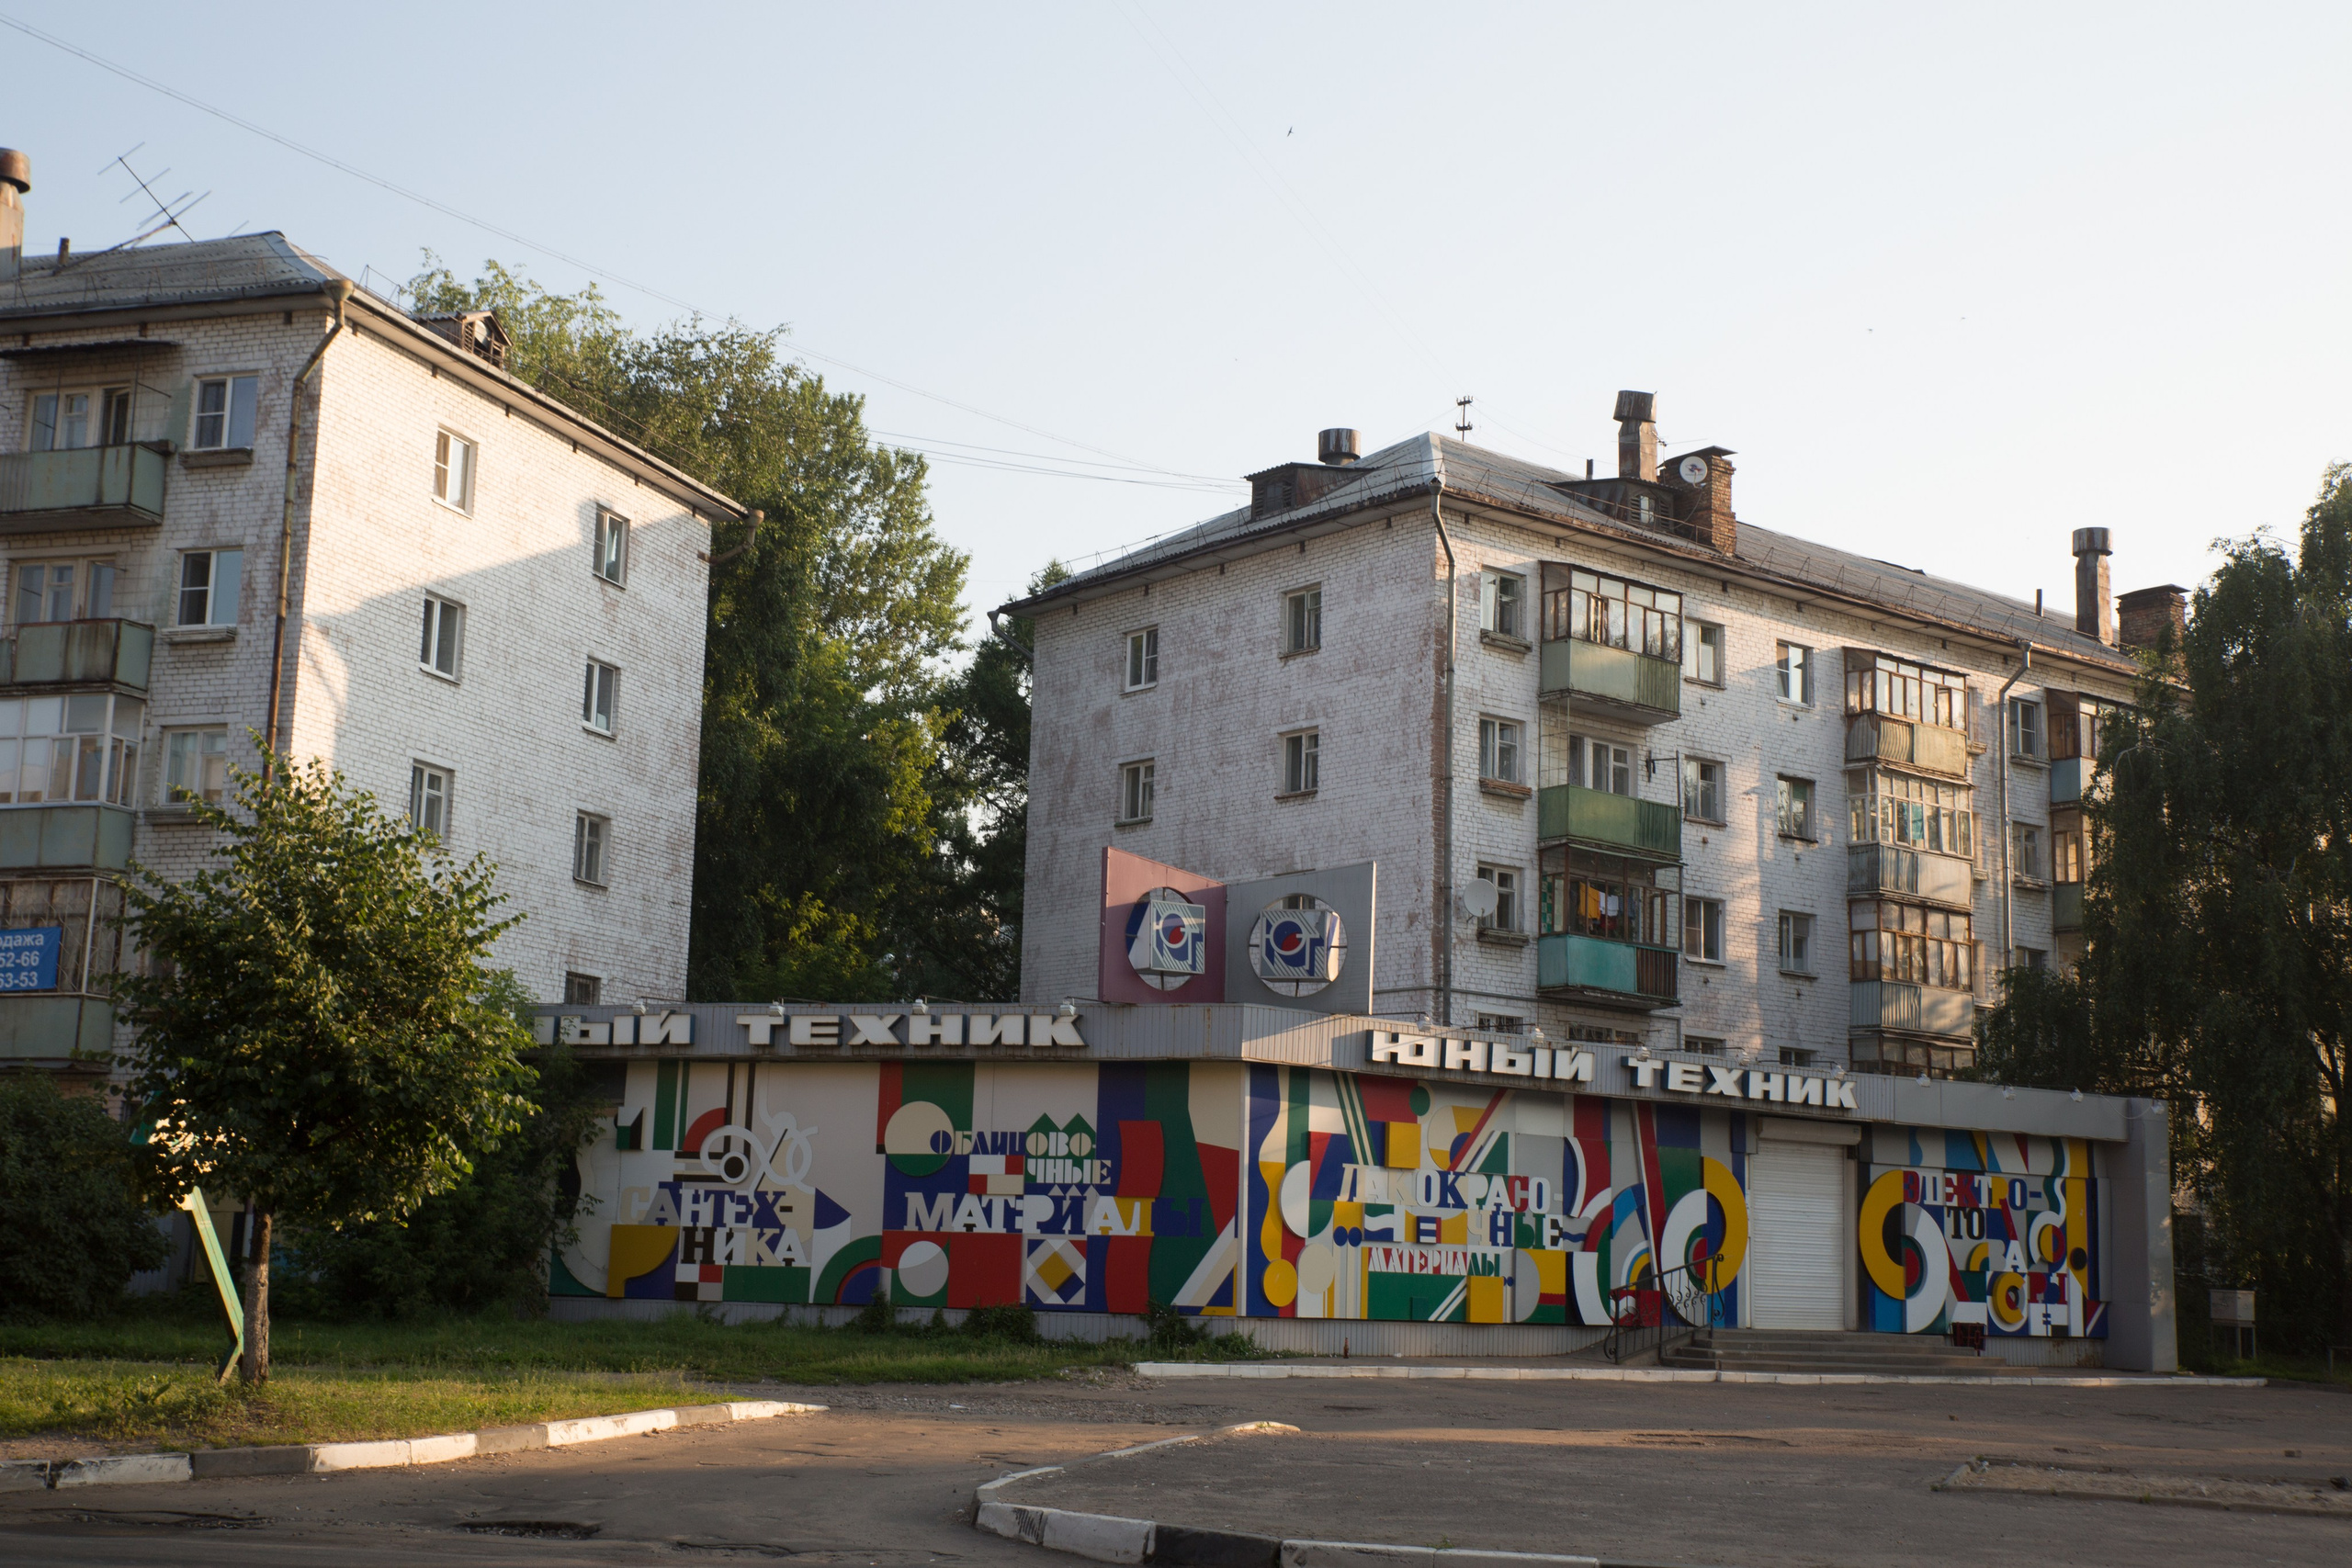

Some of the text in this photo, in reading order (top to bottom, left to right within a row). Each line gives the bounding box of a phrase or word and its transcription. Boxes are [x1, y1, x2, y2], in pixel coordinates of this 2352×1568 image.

[0, 933, 44, 950] дажа
[736, 1013, 1089, 1046] ТЕХНИК
[1365, 1029, 1860, 1110] ЮНЫЙ ТЕХНИК
[1026, 1158, 1111, 1184] ЧНЫЕ
[904, 1191, 1204, 1237] МАТЕРИАЛЫ
[1467, 1209, 1563, 1250] ЧНЫЕ
[1947, 1206, 1985, 1240] ТО
[681, 1226, 811, 1267] НИКА
[1368, 1247, 1499, 1277] МАТЕРИАЛЫ
